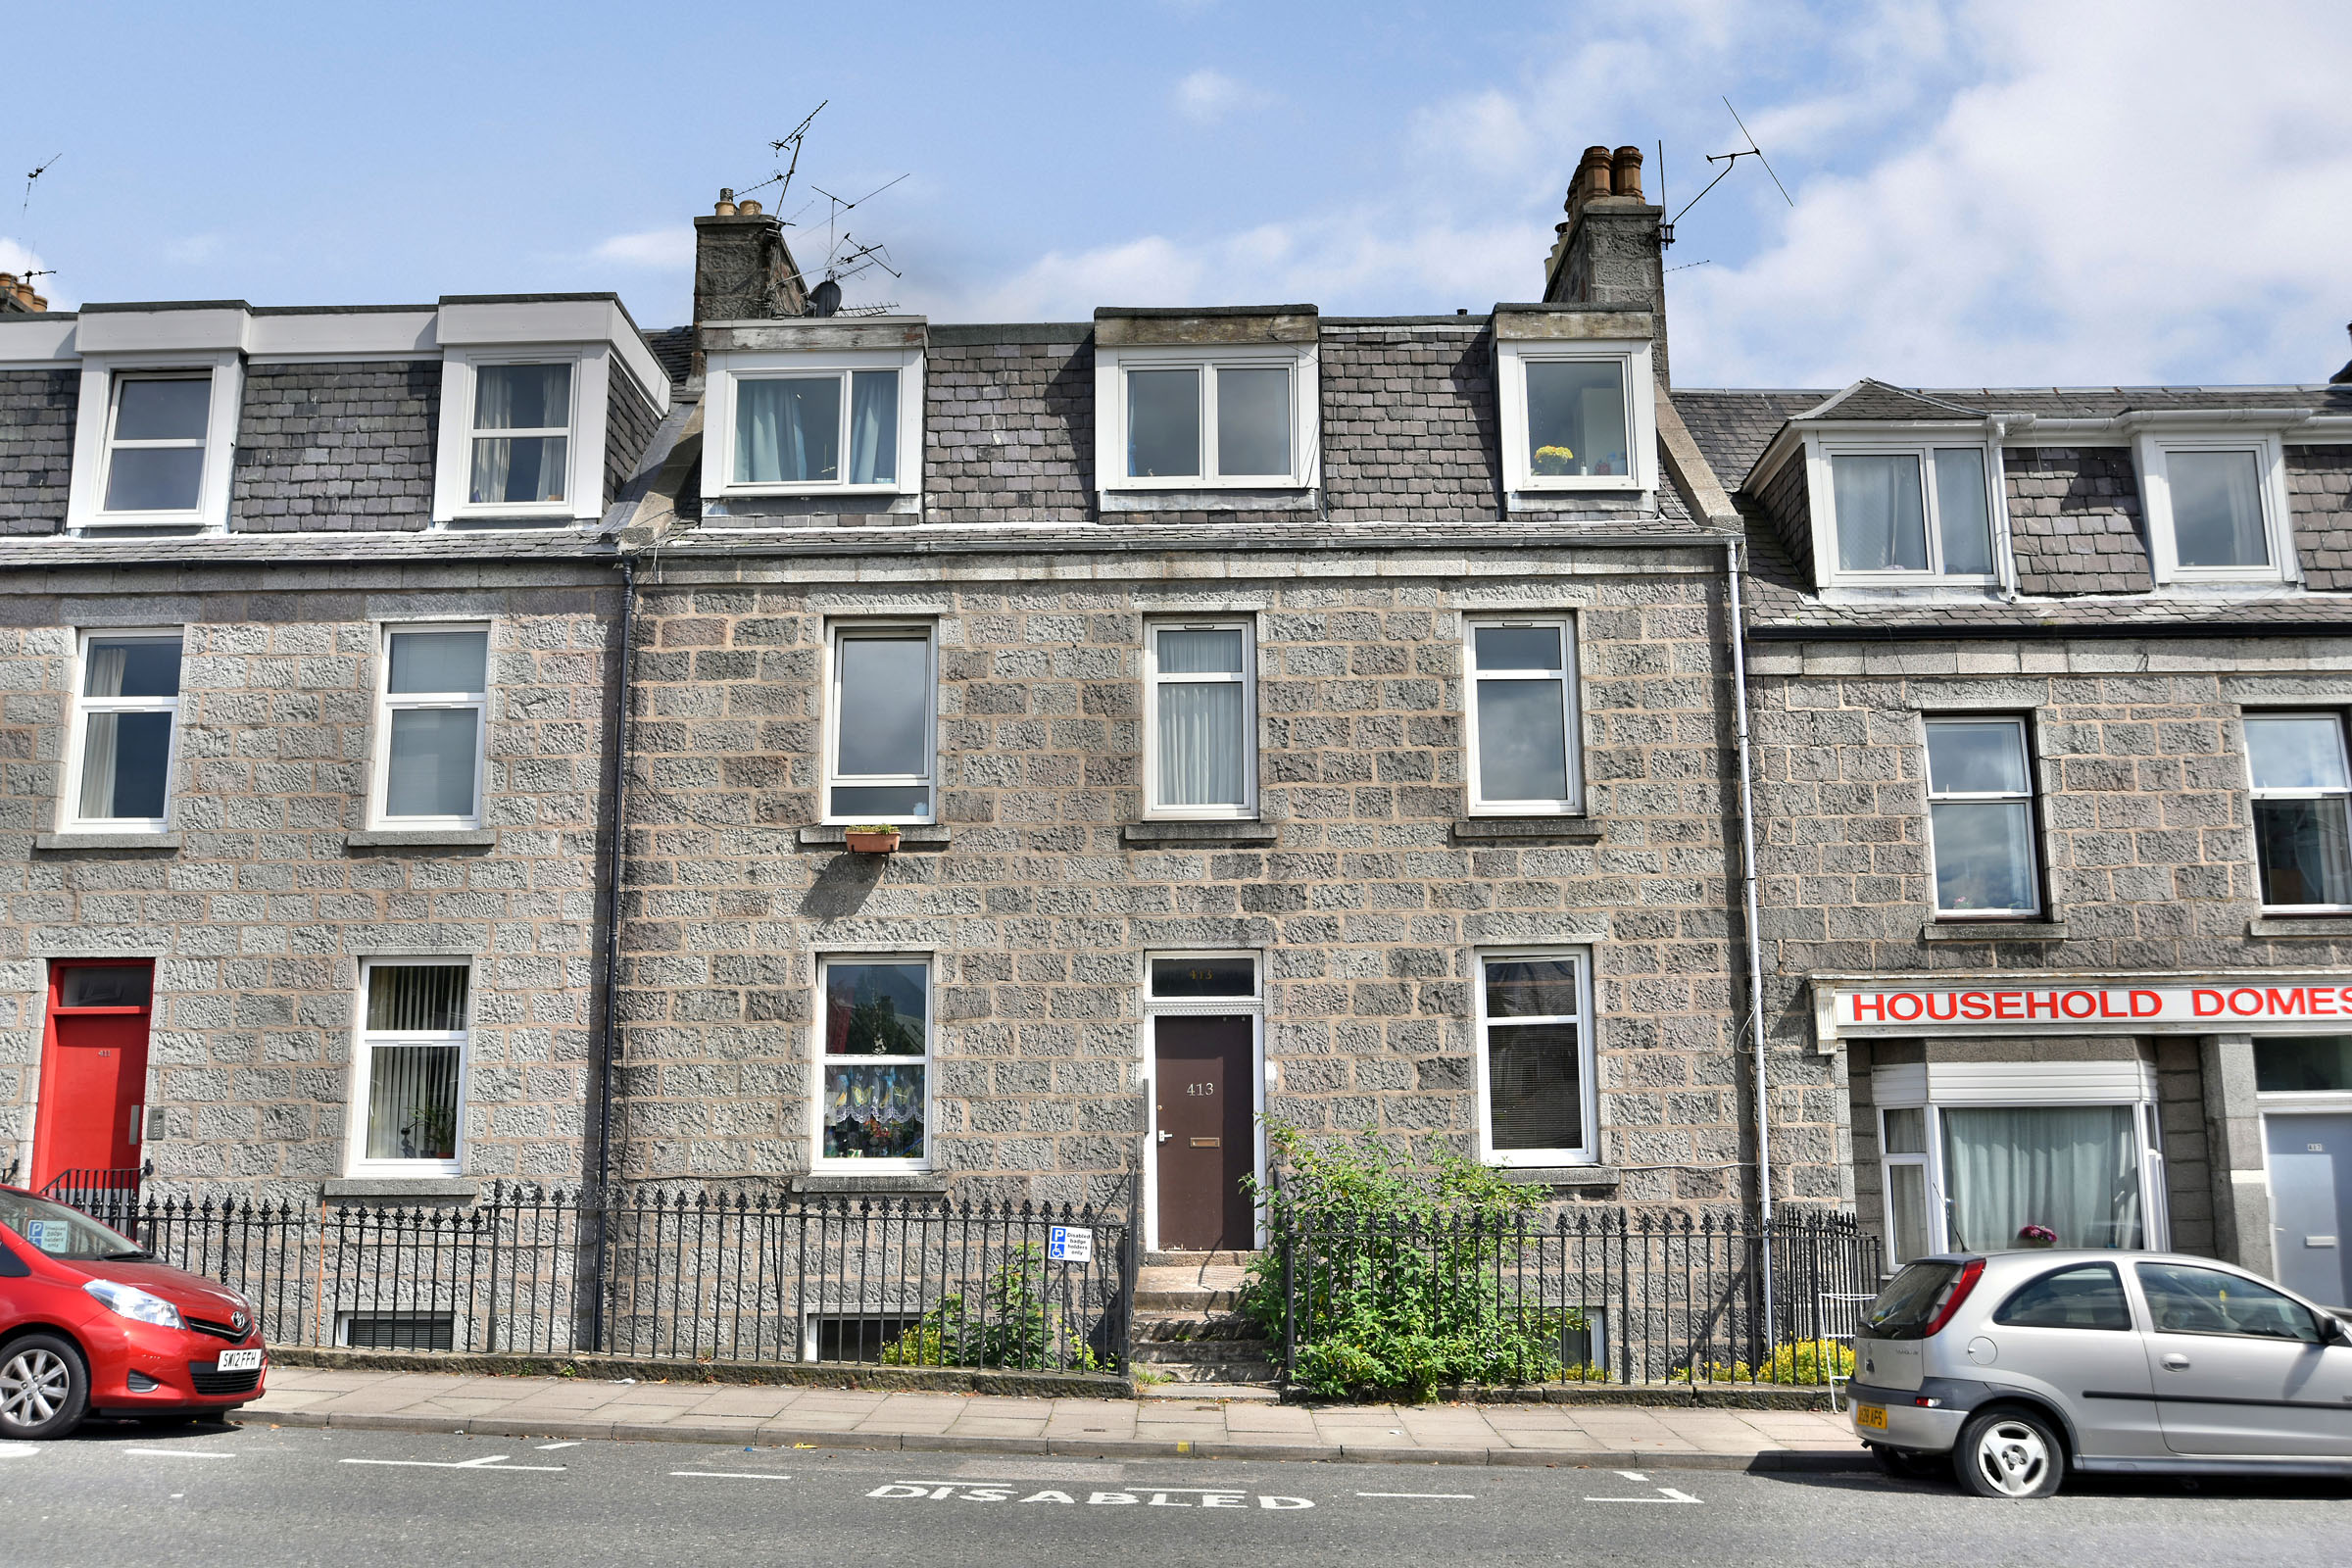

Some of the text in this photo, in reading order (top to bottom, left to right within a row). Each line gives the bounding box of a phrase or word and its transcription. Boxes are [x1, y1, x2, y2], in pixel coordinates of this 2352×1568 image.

[1188, 969, 1214, 980] 413
[1852, 990, 2163, 1021] HOUSEHOLD
[1186, 1082, 1214, 1097] 413
[32, 1223, 42, 1236] P
[1054, 1229, 1064, 1241] P
[223, 1351, 257, 1367] SW12 FFH
[864, 1485, 1316, 1510] DISABLED
